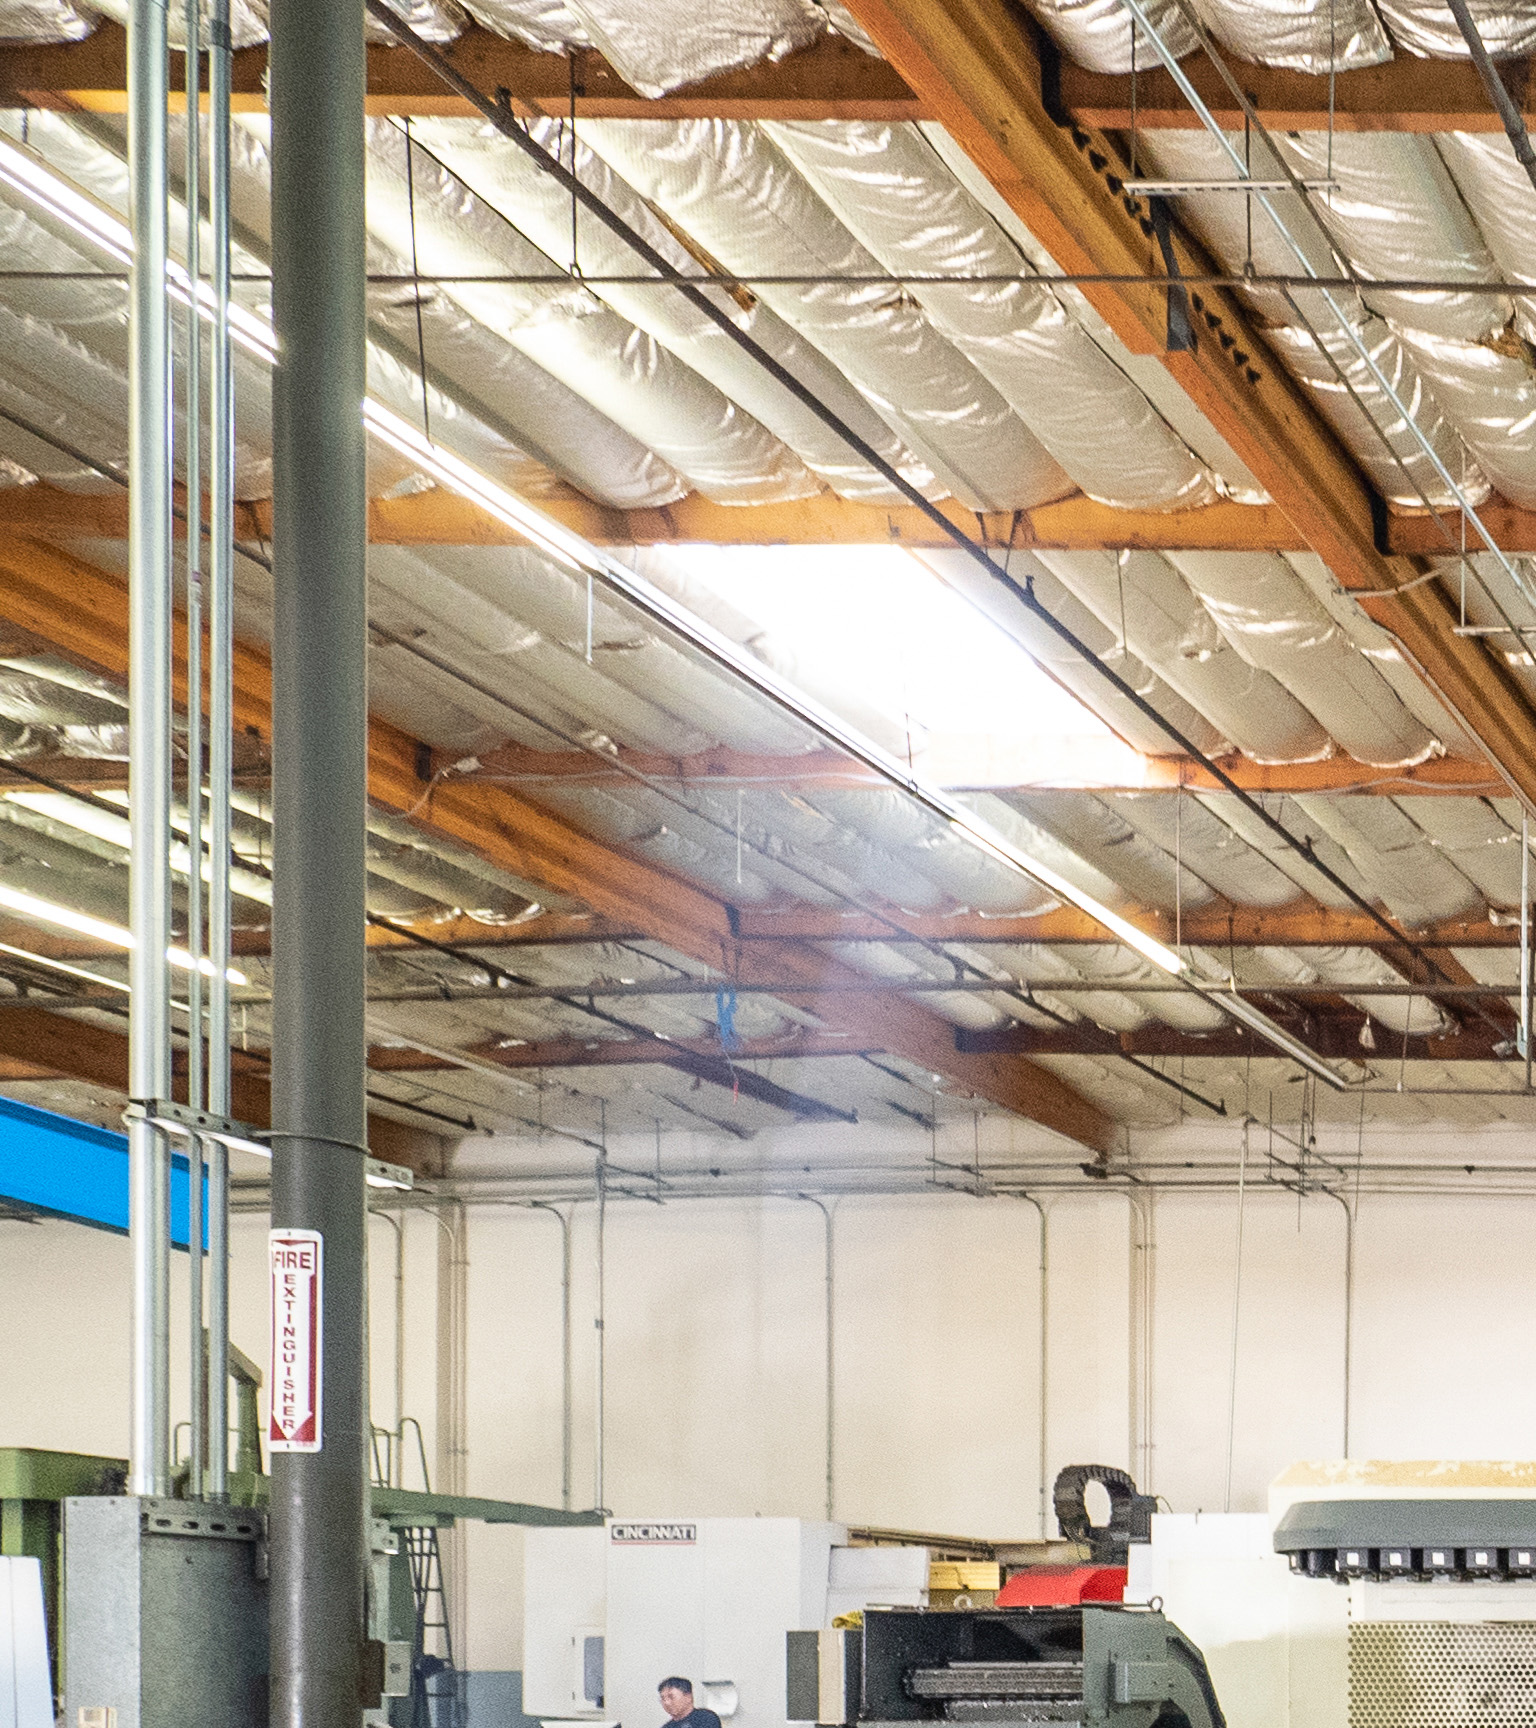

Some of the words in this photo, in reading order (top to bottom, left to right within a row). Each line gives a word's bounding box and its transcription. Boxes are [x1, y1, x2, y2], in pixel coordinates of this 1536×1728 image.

[275, 1251, 311, 1269] FIRE
[284, 1274, 296, 1429] EXTINGUISHER
[612, 1525, 695, 1540] CINCINNATI
